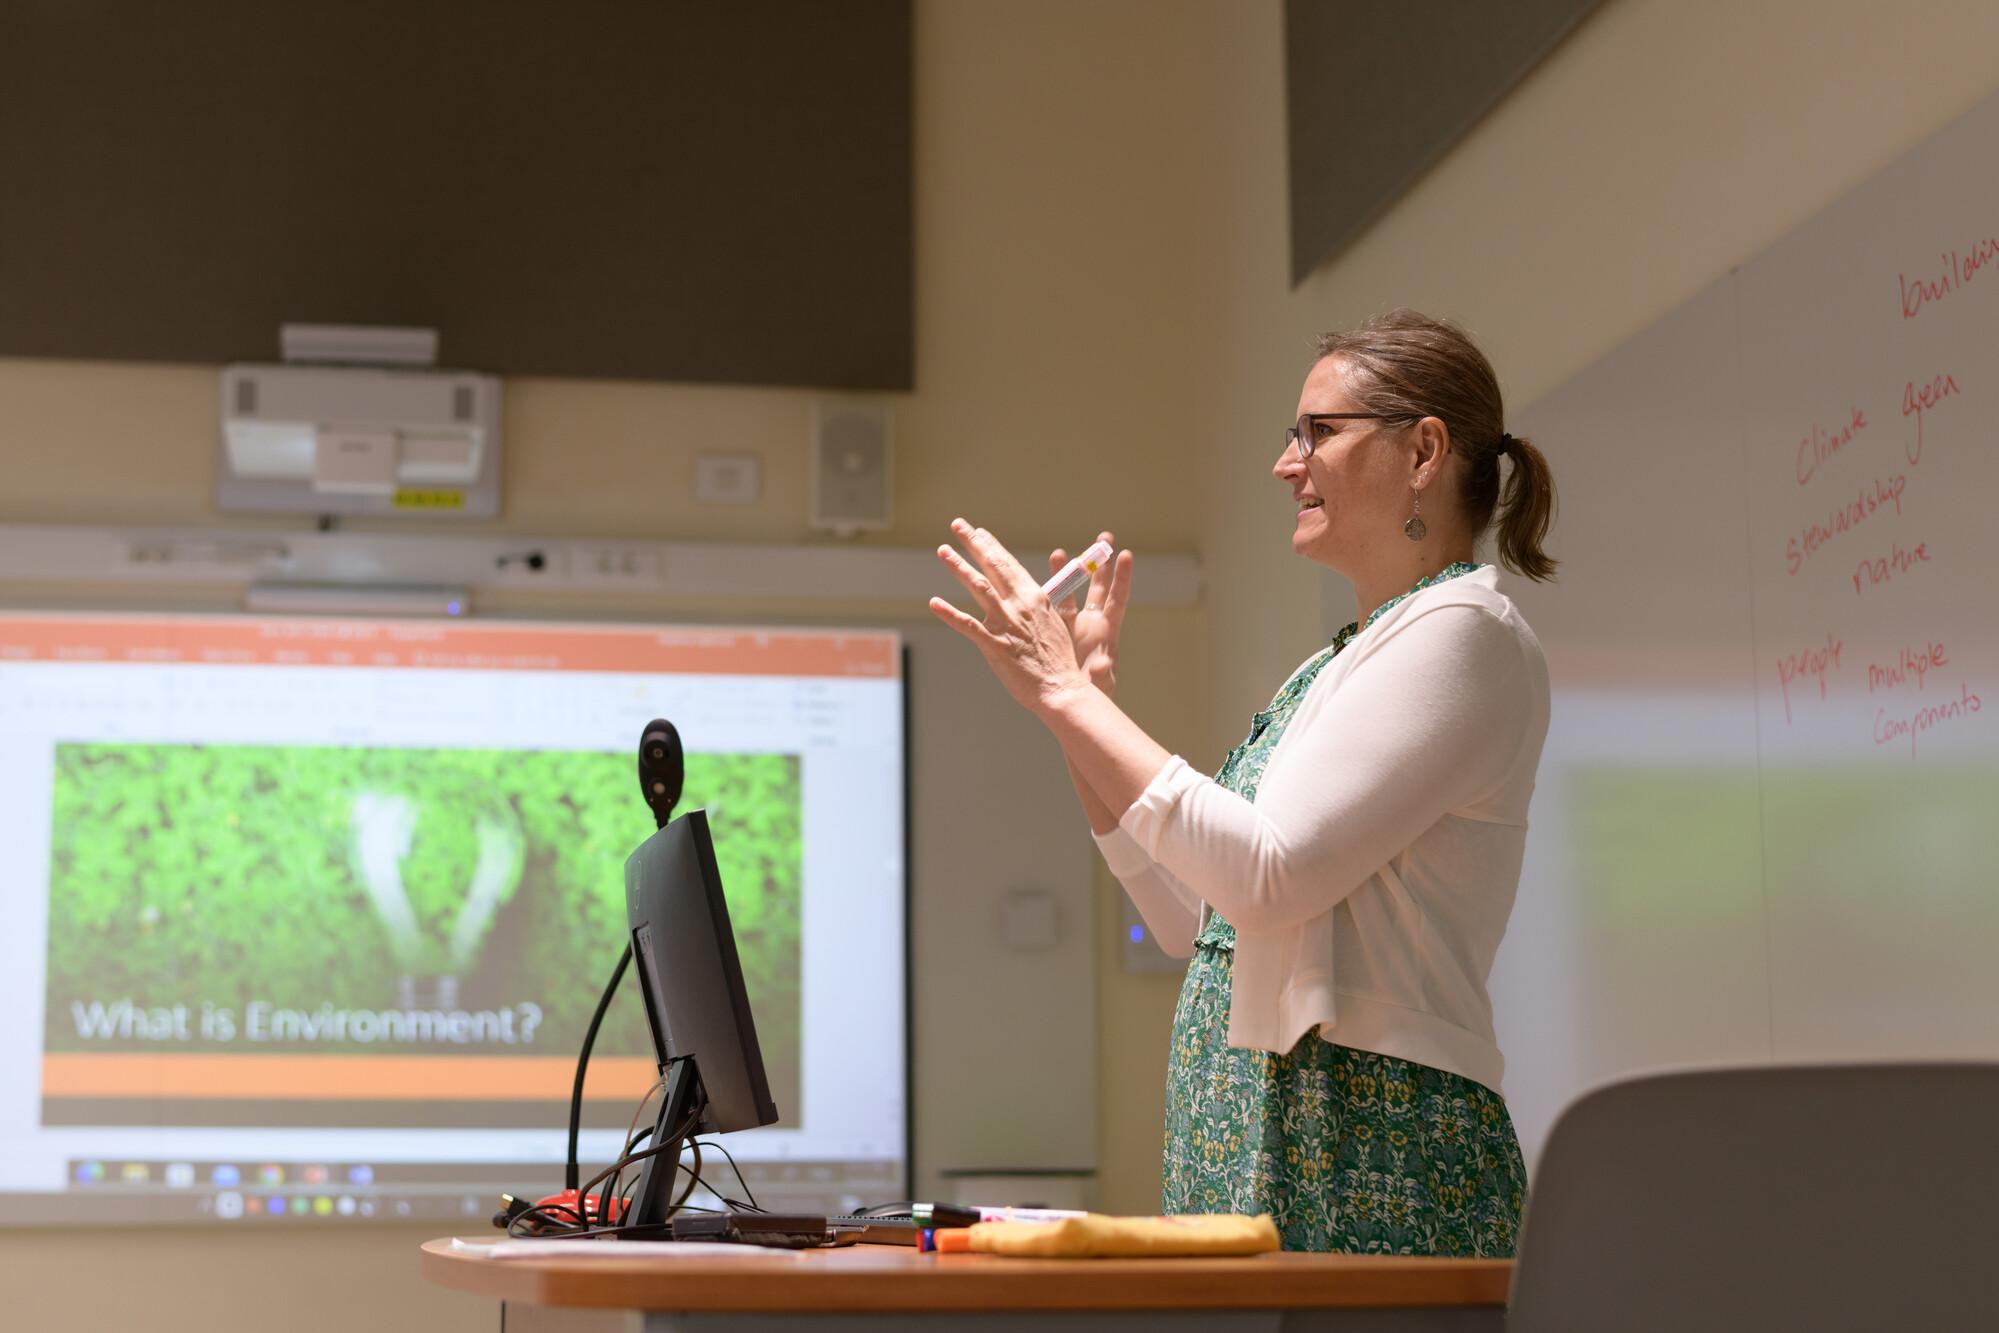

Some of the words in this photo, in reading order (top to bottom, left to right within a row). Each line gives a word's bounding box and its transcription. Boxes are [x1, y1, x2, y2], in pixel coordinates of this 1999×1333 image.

[1899, 238, 1999, 319] buildin
[1853, 542, 1931, 595] nature
[72, 999, 191, 1041] What
[203, 1001, 236, 1041] is
[245, 1000, 544, 1044] Environment?
